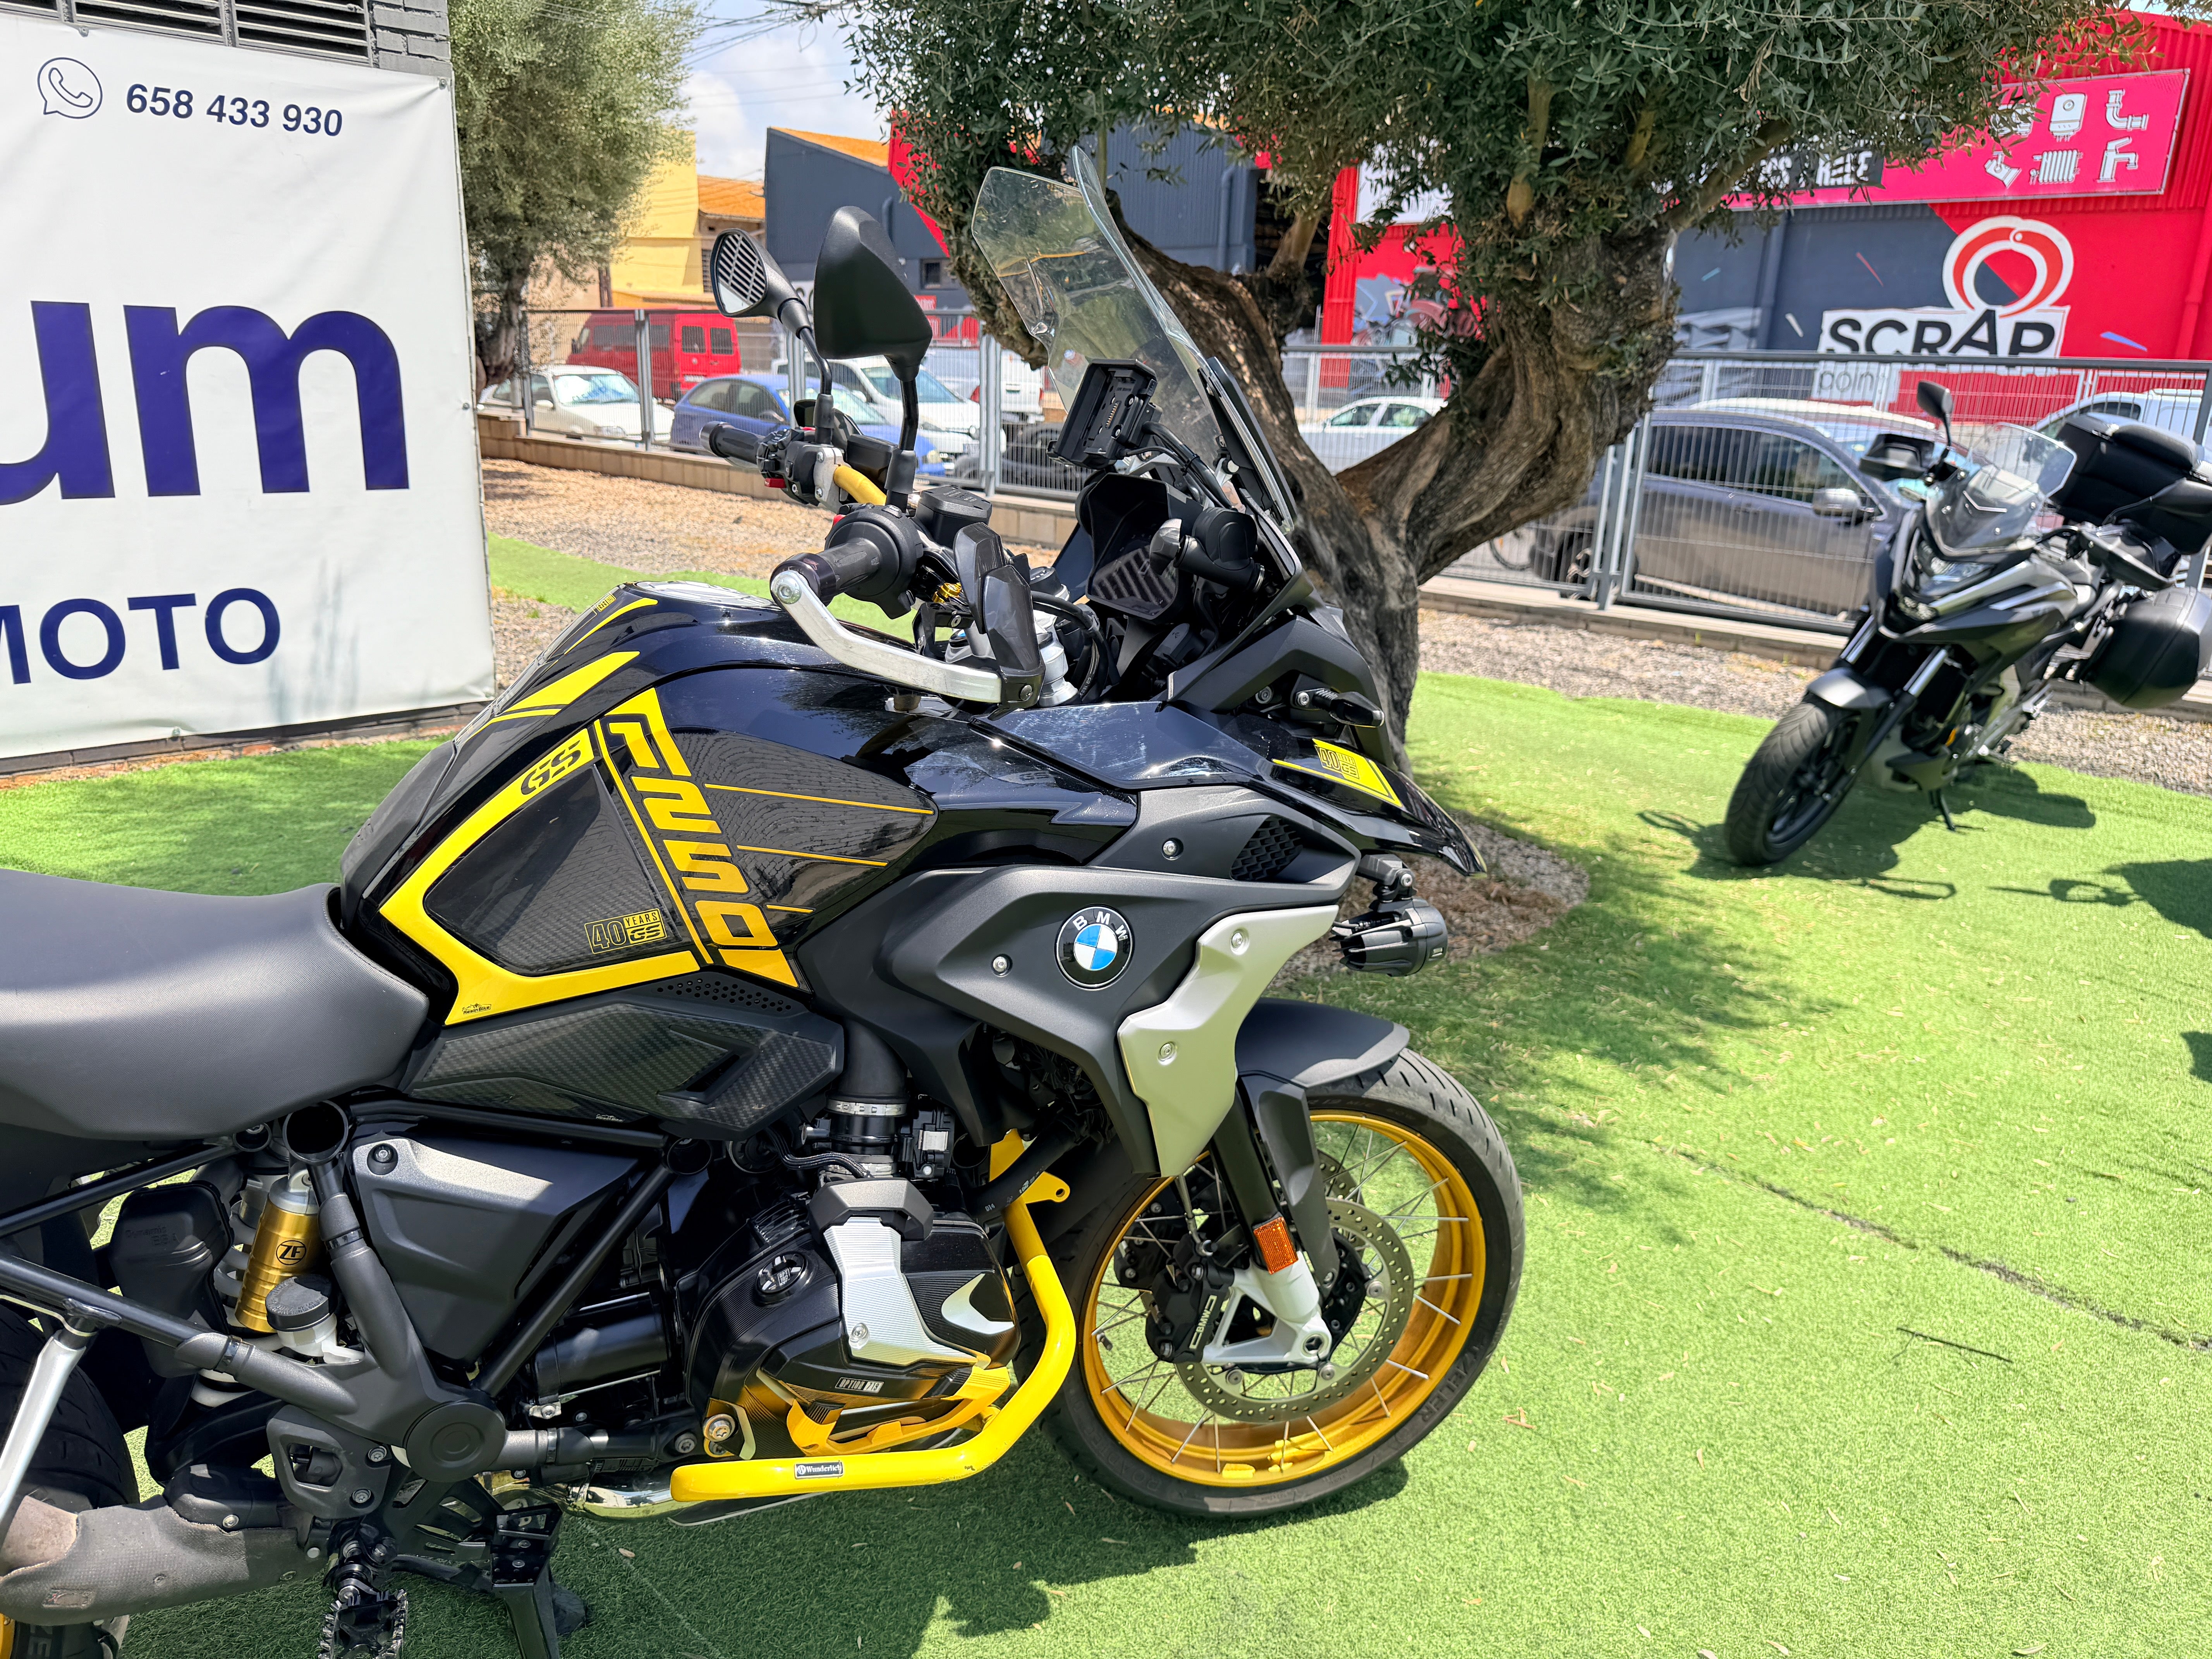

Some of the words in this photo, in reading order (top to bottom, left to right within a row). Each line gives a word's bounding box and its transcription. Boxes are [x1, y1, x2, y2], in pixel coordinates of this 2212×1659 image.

[126, 83, 194, 118] 658
[206, 95, 270, 128] 433
[282, 104, 343, 136] 930
[1829, 310, 2055, 361] SCRAP
[520, 739, 581, 795] GS
[1319, 747, 1341, 771] 40
[625, 912, 658, 927] YEARS
[1072, 910, 1128, 941] BMW
[591, 921, 627, 949] 40
[629, 924, 661, 940] GS
[280, 1244, 303, 1261] ZF
[1196, 1309, 1211, 1333] BMW
[839, 1379, 865, 1389] OPTION
[867, 1382, 879, 1391] 719
